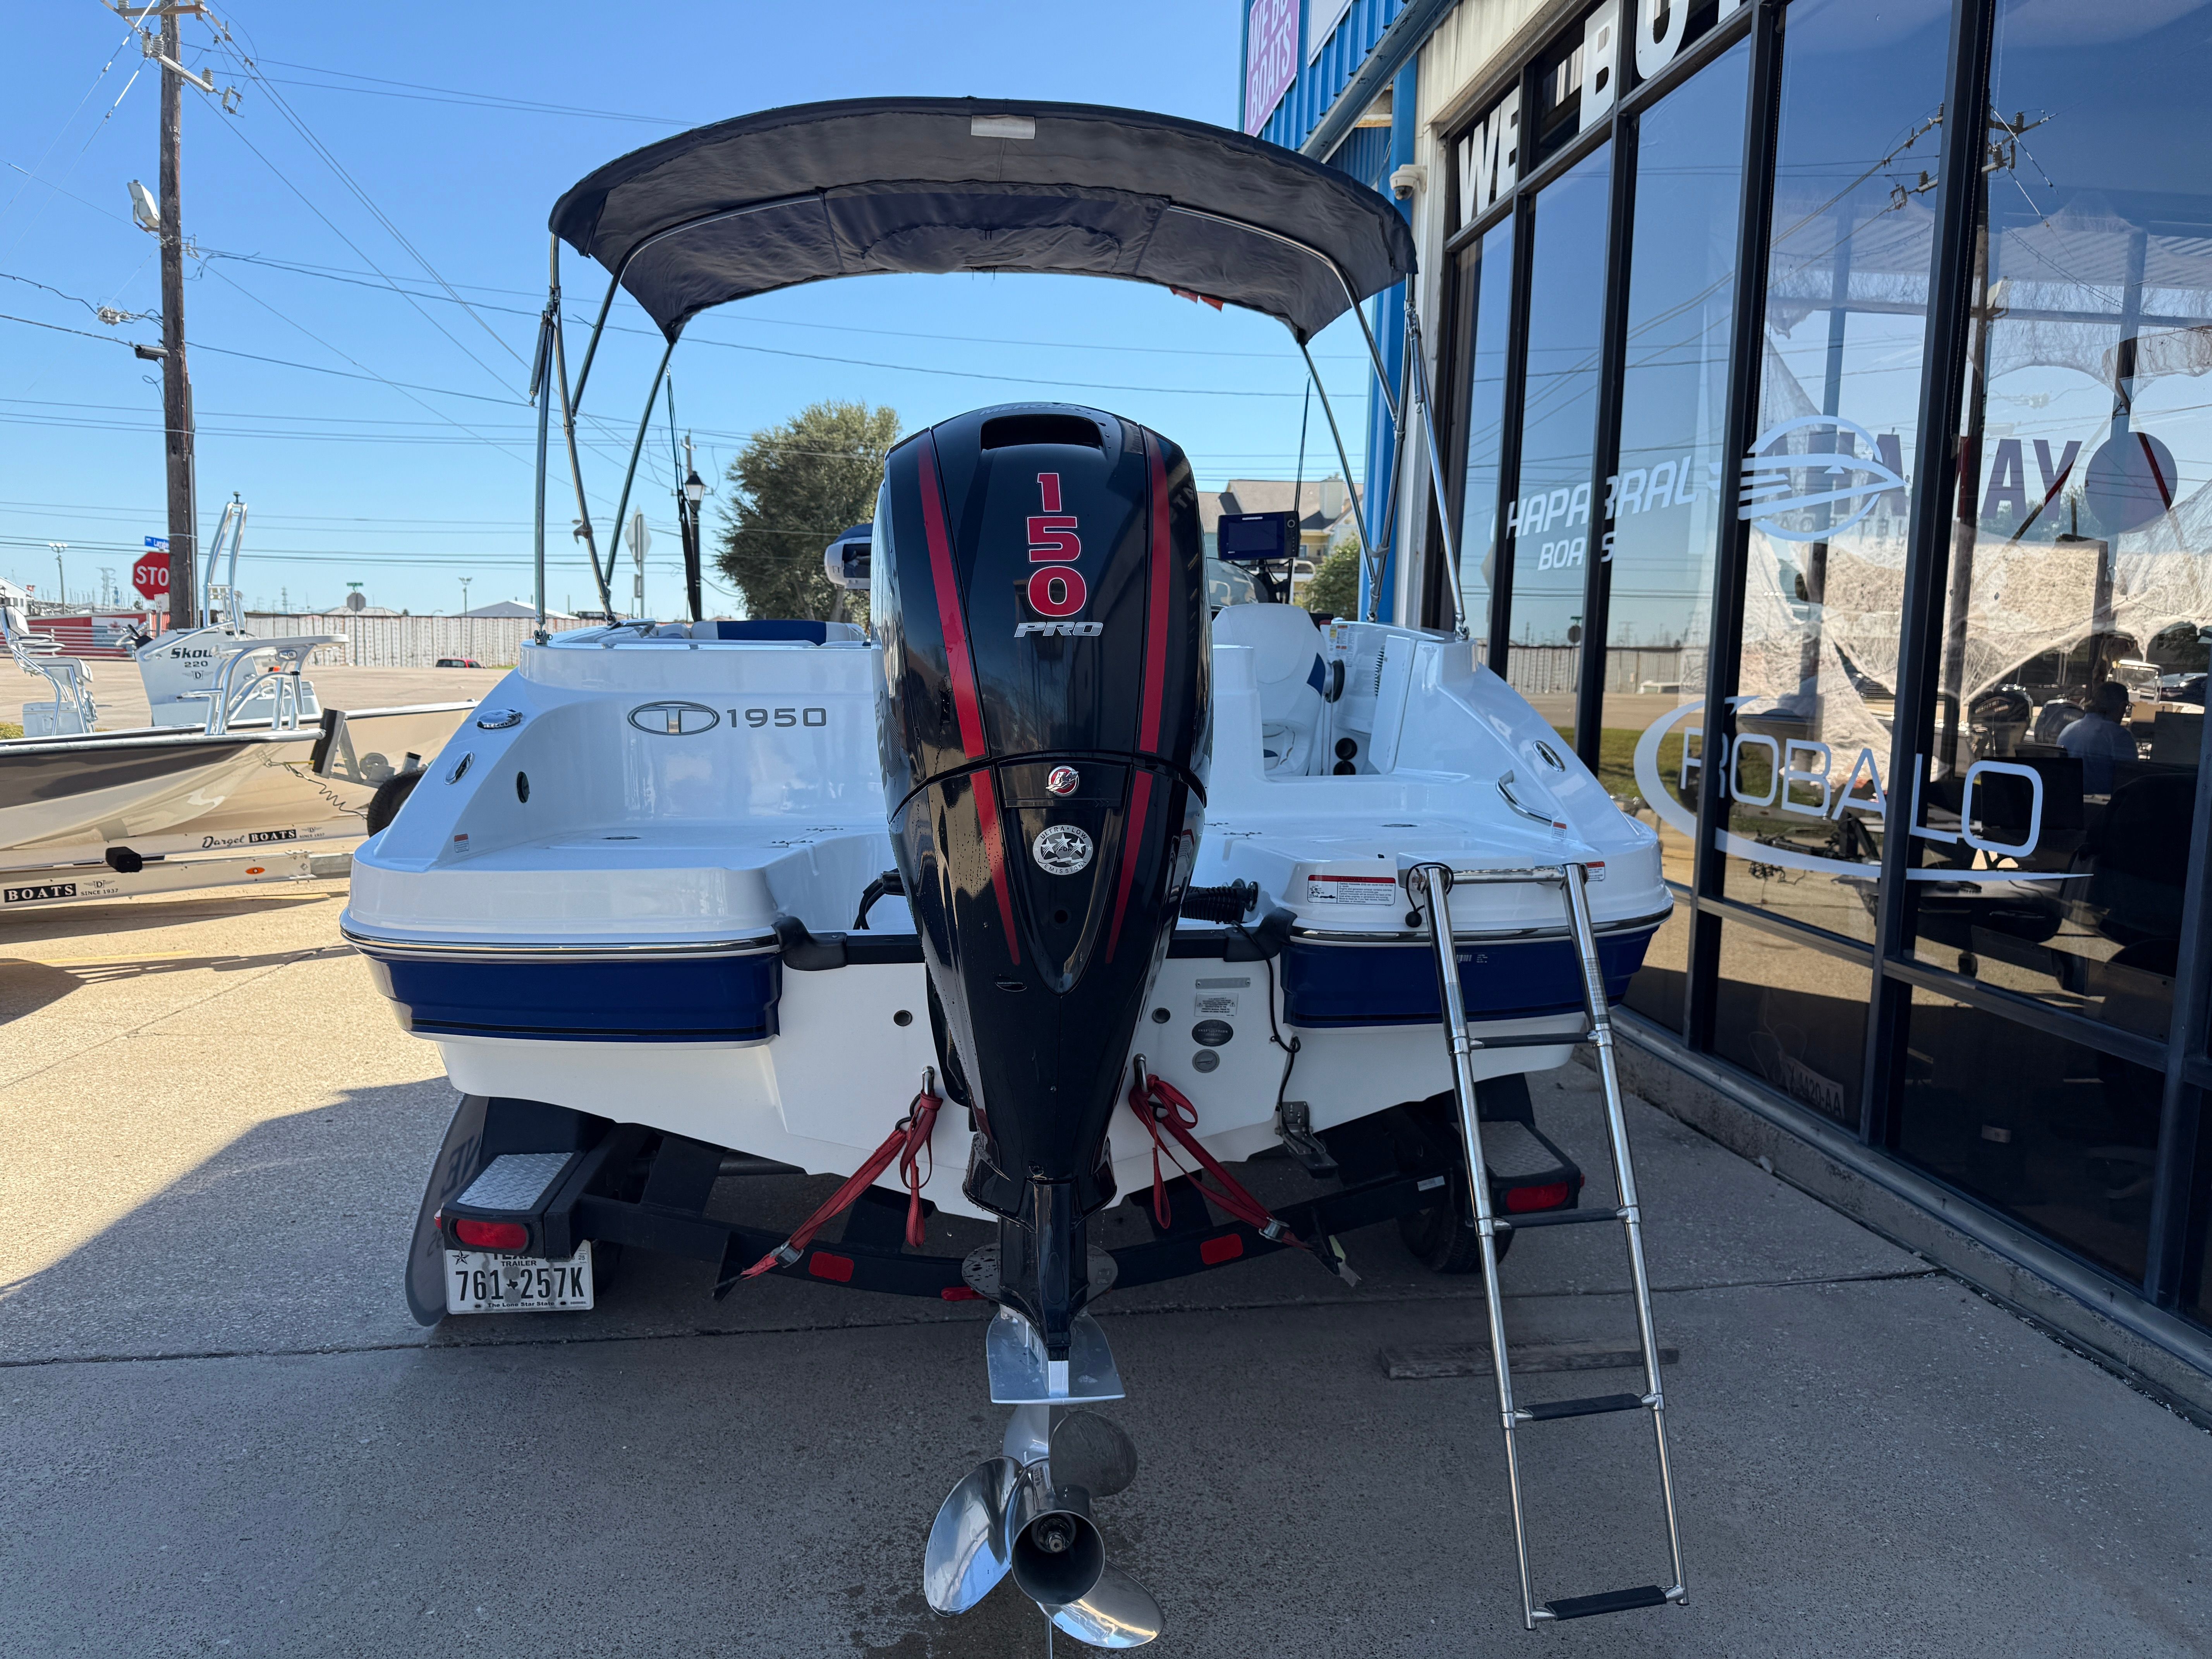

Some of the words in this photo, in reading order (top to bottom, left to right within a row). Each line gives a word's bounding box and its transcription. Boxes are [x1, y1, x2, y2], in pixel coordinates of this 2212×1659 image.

[1250, 12, 1291, 131] BOATS
[1458, 85, 1520, 229] WE
[1489, 455, 1698, 543] HAPARRAL
[1026, 472, 1087, 617] 150
[1537, 531, 1618, 571] BOAS
[136, 565, 169, 586] STO
[1014, 622, 1103, 638] PRO
[170, 647, 212, 659] Skou
[727, 708, 826, 728] 1950
[1680, 726, 2043, 857] ROBALO
[251, 830, 295, 842] BOATS
[1040, 826, 1065, 839] ULTRA
[1072, 827, 1087, 839] LOW
[1044, 863, 1084, 874] EMISSION
[8, 885, 74, 901] BOATS
[455, 1269, 503, 1301] 761
[520, 1267, 584, 1299] 257K
